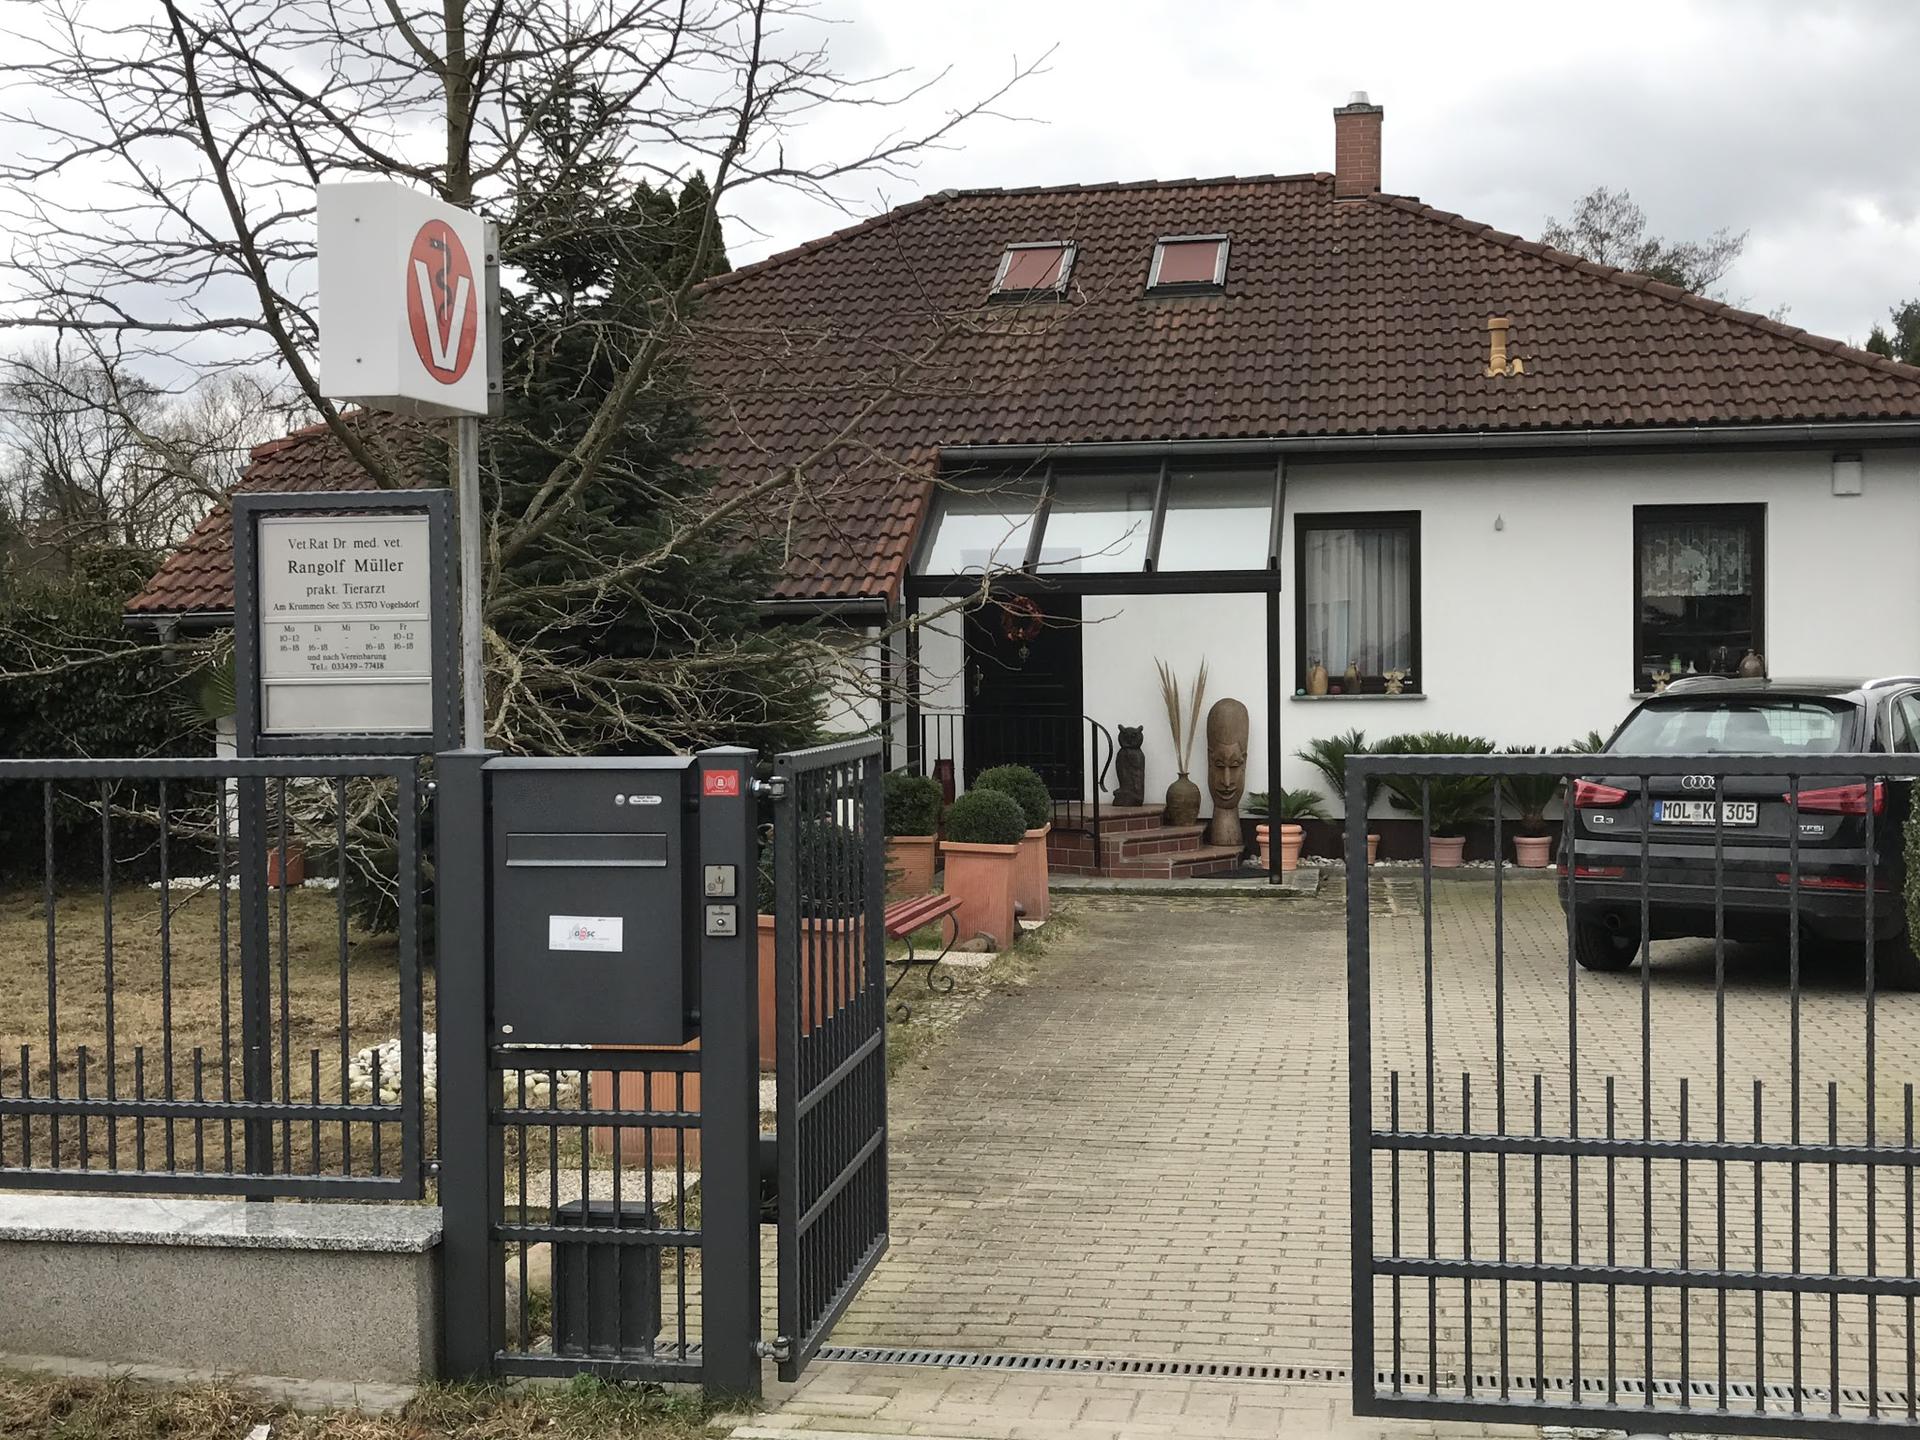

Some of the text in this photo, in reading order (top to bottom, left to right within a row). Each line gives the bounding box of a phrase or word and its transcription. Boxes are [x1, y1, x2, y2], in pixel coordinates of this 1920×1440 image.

[288, 558, 404, 576] Rangolf Müller
[342, 583, 386, 594] Tierarzt
[273, 603, 286, 611] Am
[288, 602, 325, 611] Krummen
[327, 601, 340, 610] See
[380, 600, 420, 610] Vogelsdorf
[313, 624, 322, 632] Di
[369, 623, 380, 631] Do
[307, 653, 387, 661] und nach Vereinbarung
[1662, 802, 1691, 819] MOL
[1725, 803, 1755, 821] 305
[1593, 815, 1614, 825] Q3
